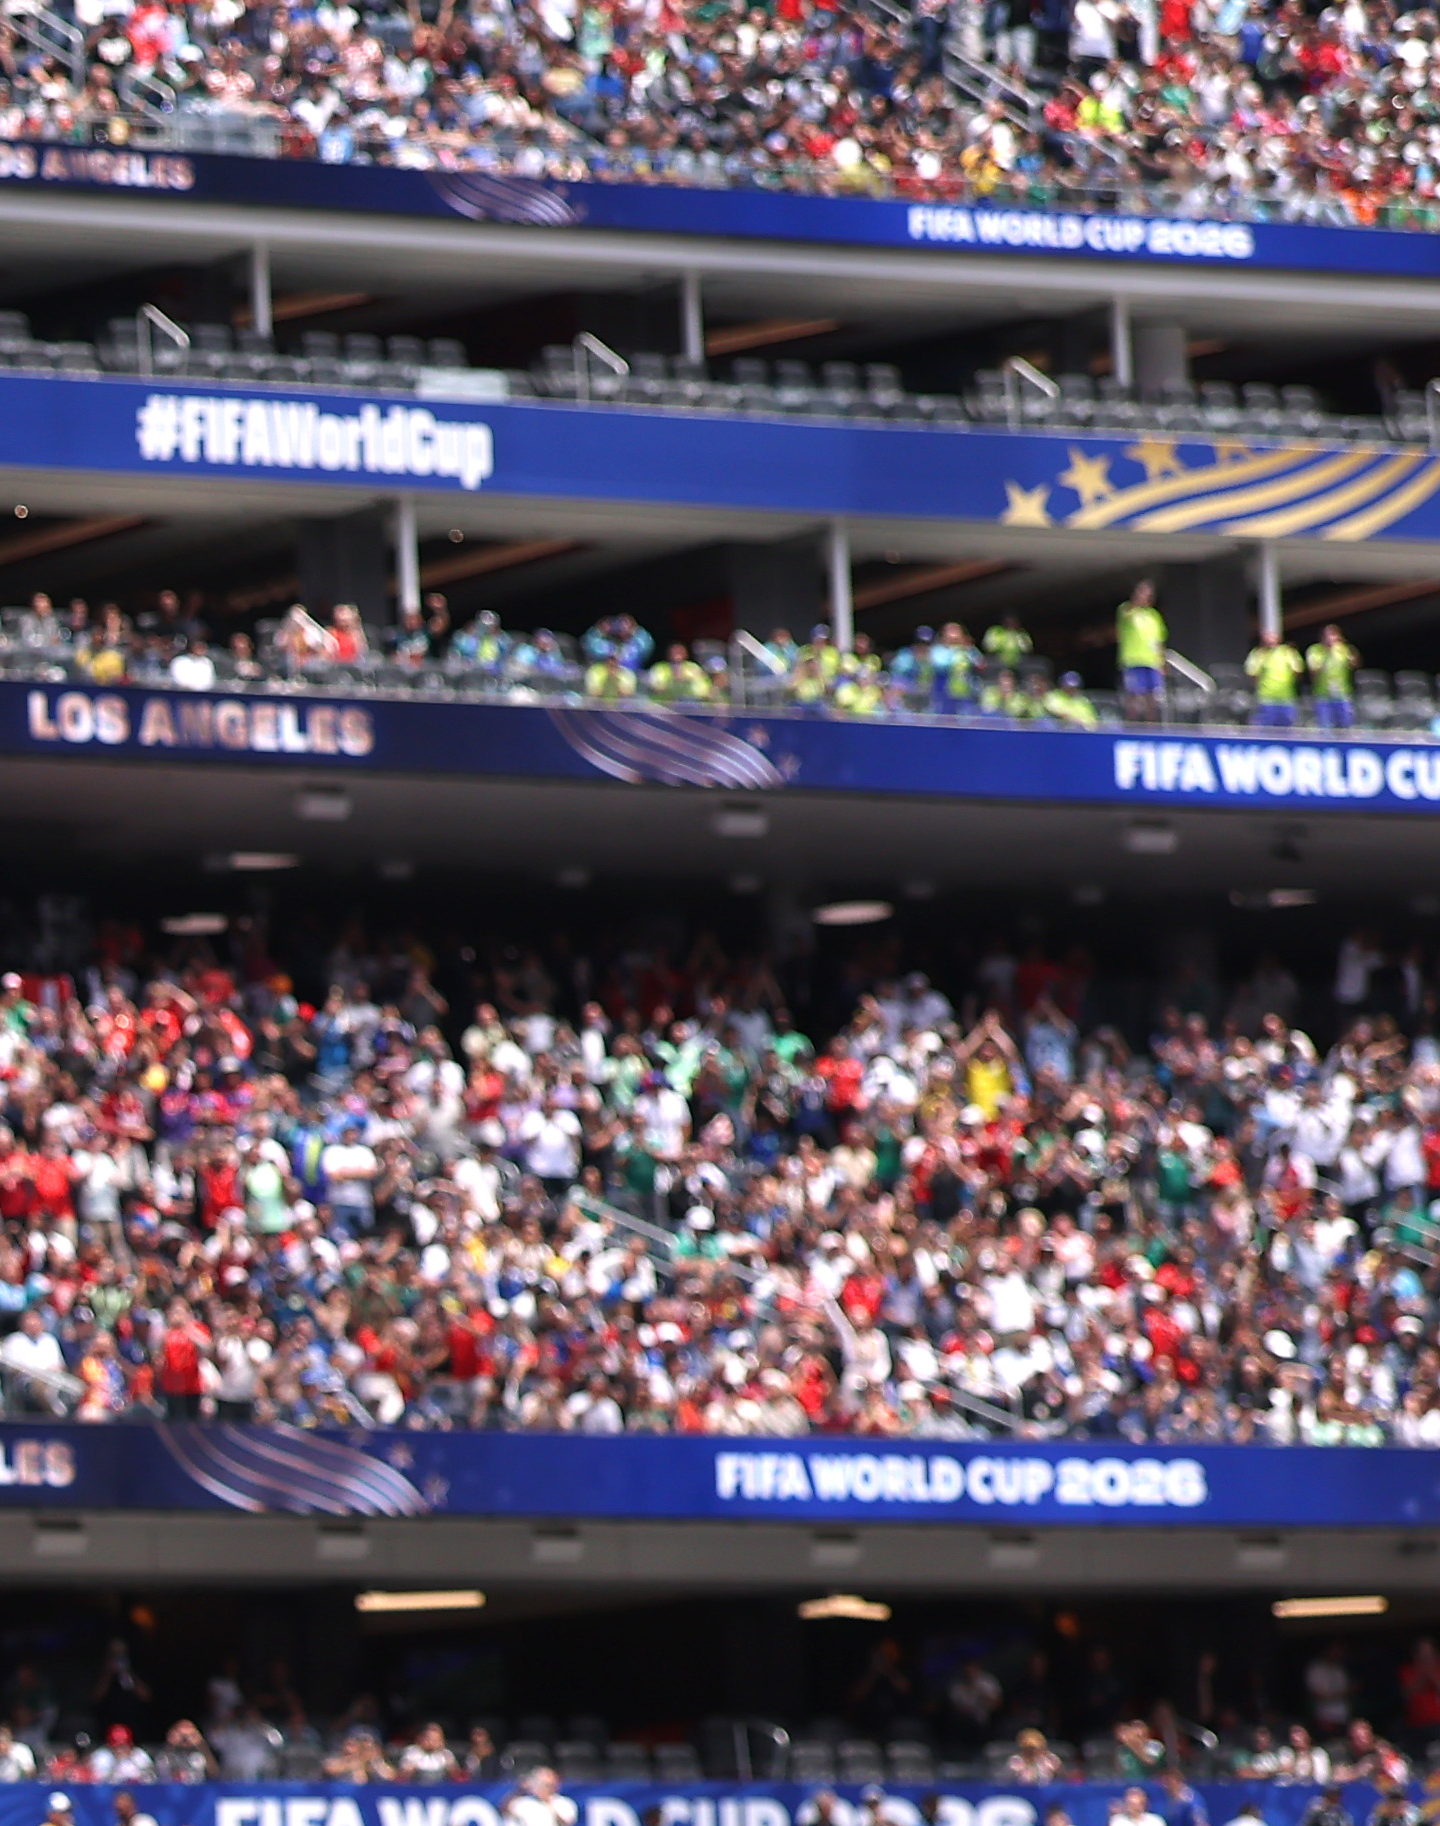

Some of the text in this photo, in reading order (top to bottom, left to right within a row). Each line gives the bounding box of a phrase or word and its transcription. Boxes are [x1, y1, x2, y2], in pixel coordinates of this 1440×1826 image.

[909, 207, 1252, 259] FIFA WORLD CUP 2026
[137, 394, 492, 489] #FIFAWorldCup
[28, 690, 375, 757] LOS ANGELES
[1115, 741, 1217, 792] FIFA
[1216, 745, 1386, 799] WORLD
[716, 1452, 1207, 1507] FIFA WORLD CUP 2026
